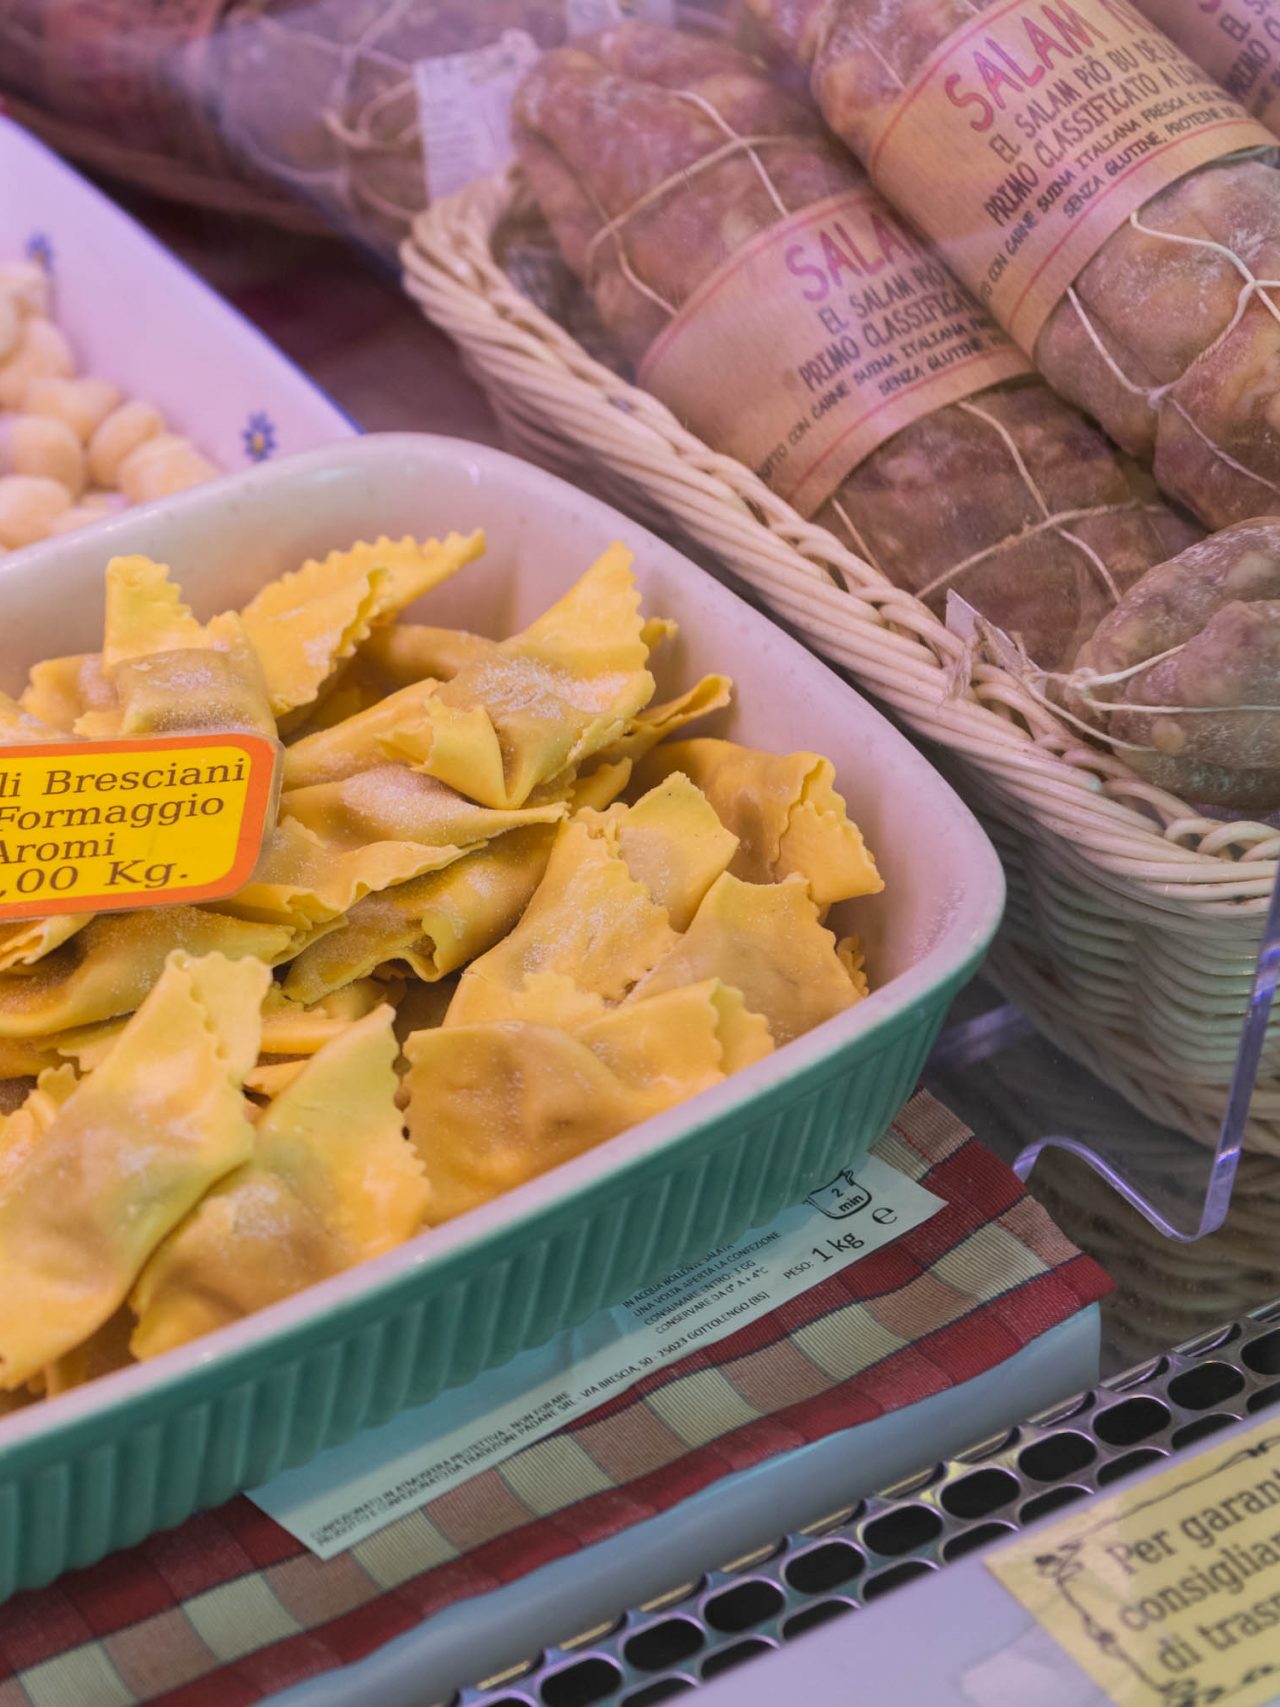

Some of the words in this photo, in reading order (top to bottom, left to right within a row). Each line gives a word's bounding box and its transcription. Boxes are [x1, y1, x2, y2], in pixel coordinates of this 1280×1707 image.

[988, 133, 1021, 165] EL
[1014, 78, 1082, 140] SALAM
[983, 161, 1040, 228] PRIMO
[1033, 71, 1160, 170] CLASSIFICATO
[1036, 169, 1077, 215] SUINA
[1073, 118, 1140, 171] ITALIANA
[1140, 95, 1190, 124] FRESCA
[1062, 175, 1107, 219] SENZA
[785, 213, 918, 301] SALA
[817, 305, 850, 336] EL
[849, 273, 914, 320] SALAM
[798, 335, 862, 392] PRIMO
[758, 441, 788, 482] OTTO
[900, 320, 967, 359] ITALIANA
[40, 756, 246, 796] Bresciani
[104, 860, 190, 889] Kg.
[831, 1187, 844, 1199] 2
[838, 1194, 865, 1213] min
[811, 1247, 834, 1263] 1
[826, 1232, 865, 1253] kg
[663, 1260, 705, 1287] BOLLEN
[633, 1304, 653, 1318] UNA
[652, 1286, 682, 1306] VOLTA
[655, 1296, 714, 1335] CONSERVARE
[582, 1384, 600, 1399] VIA
[687, 1300, 751, 1341] GOTTOLENGO
[1106, 1528, 1177, 1575] Per
[1157, 1633, 1202, 1674] di
